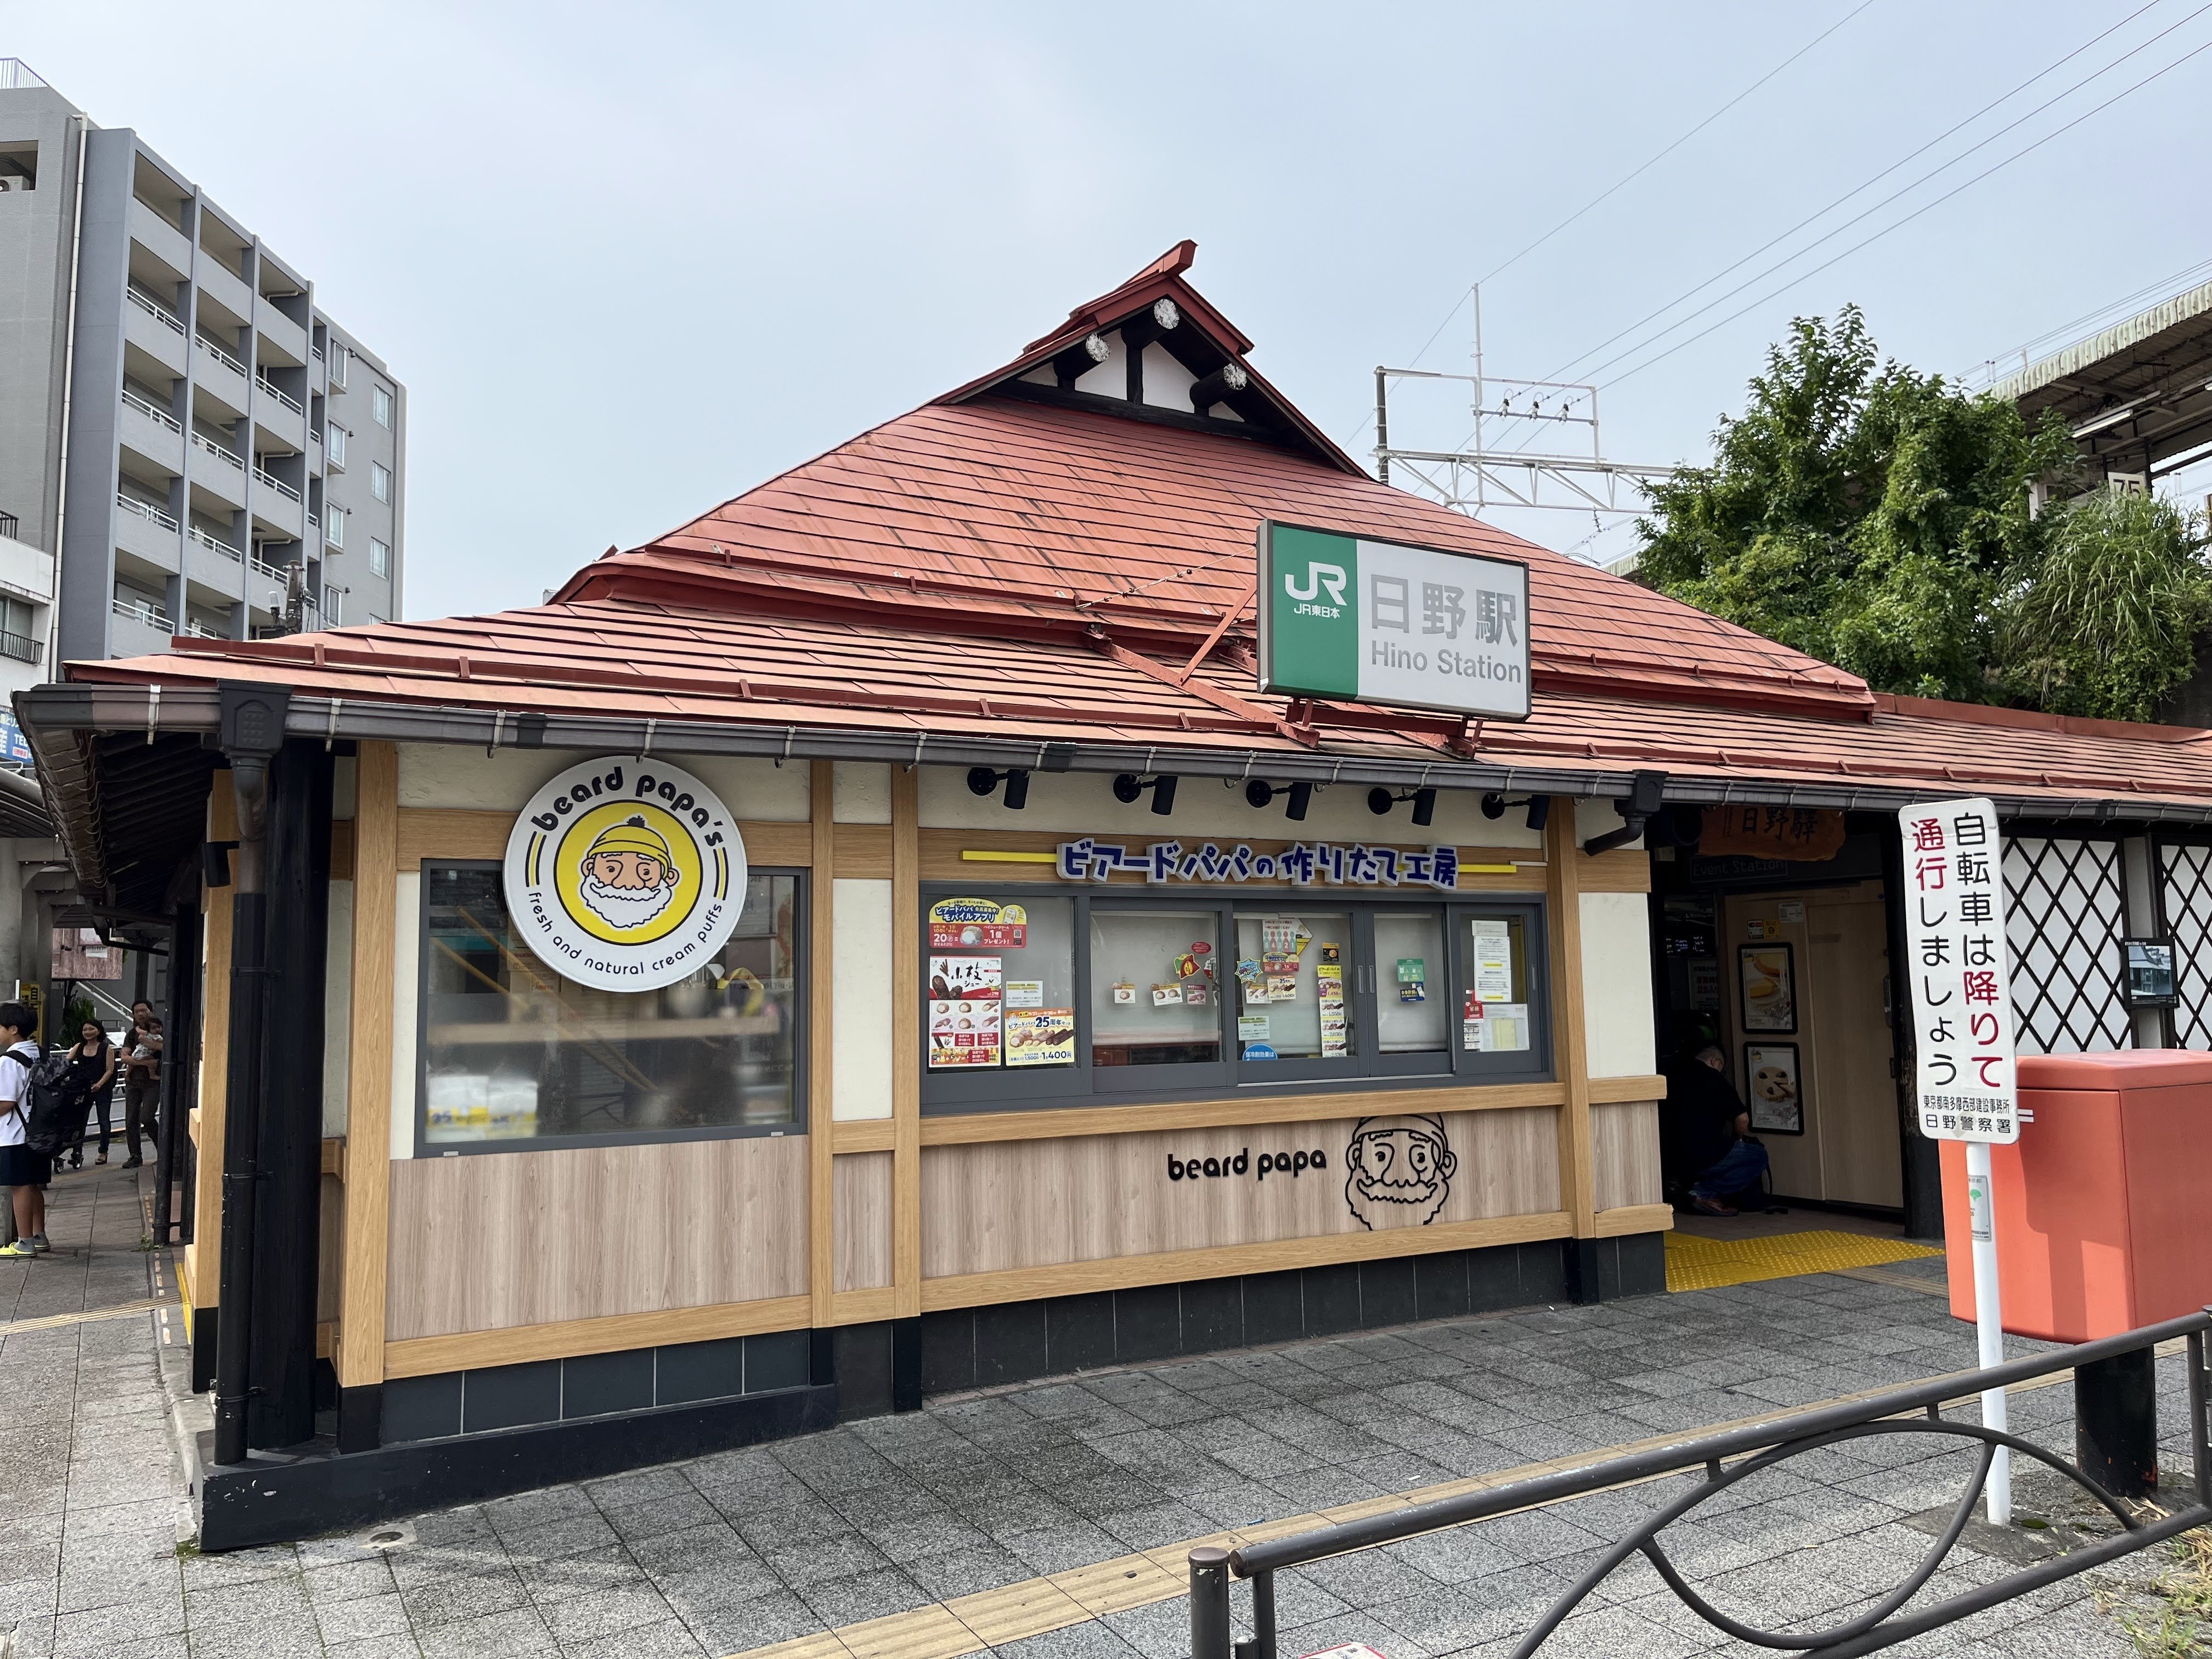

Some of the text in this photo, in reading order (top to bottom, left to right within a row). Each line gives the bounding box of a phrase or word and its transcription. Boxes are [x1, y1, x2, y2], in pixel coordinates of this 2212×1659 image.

[2113, 479, 2141, 499] 75
[1285, 561, 1347, 606] JR
[1294, 602, 1340, 619] JR東日本
[1370, 574, 1518, 647] 日野駅
[1372, 640, 1521, 683] Hino Station
[531, 766, 724, 847] beard papa's
[1061, 838, 1457, 888] ビアードパパの作りたて工房
[1694, 862, 1729, 877] Event
[528, 891, 722, 975] fresh and natural cream puffs
[943, 912, 995, 922] モバイルアプリ
[1910, 816, 1957, 1087] 通行しましょう
[1953, 811, 2004, 1088] 自転車は降りて
[1923, 1095, 2010, 1114] 東京都南多摩西部建設事務所
[1926, 1114, 2011, 1134] 日野警察署
[1167, 1147, 1327, 1182] beard papa
